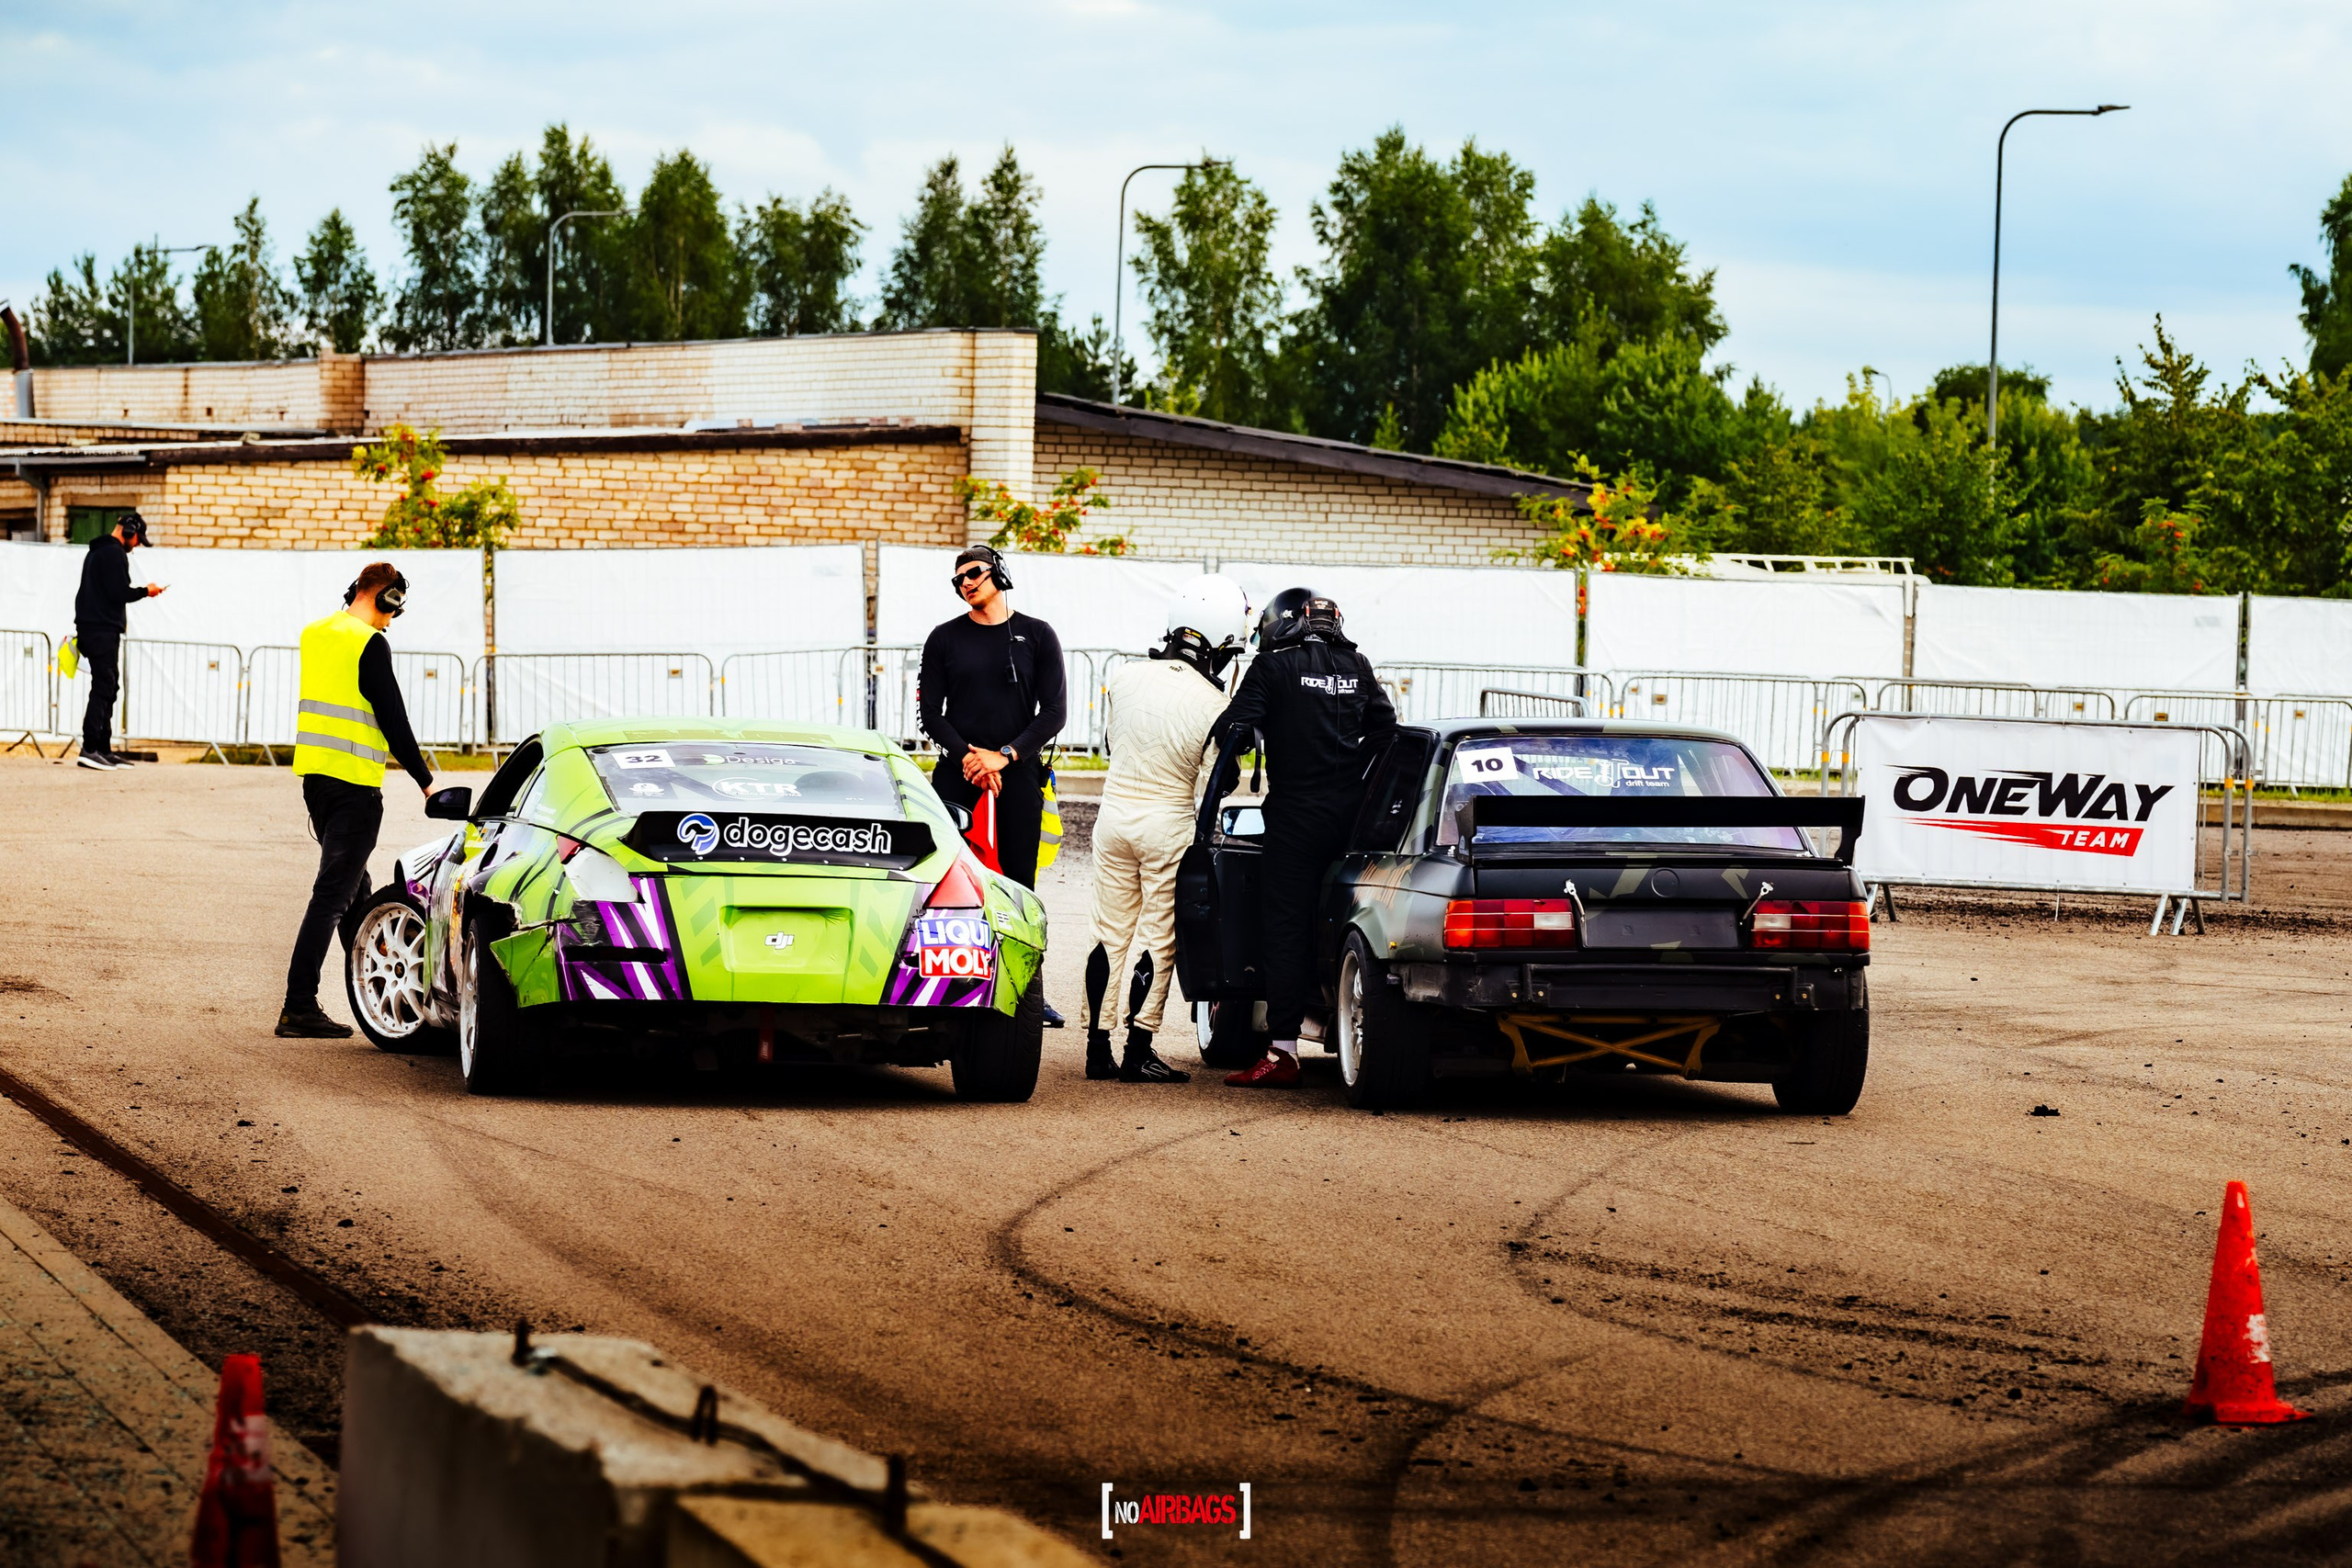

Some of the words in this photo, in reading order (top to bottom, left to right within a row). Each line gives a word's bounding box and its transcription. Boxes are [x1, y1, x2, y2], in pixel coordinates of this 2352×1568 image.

[1301, 676, 1326, 688] RIDE
[1337, 679, 1359, 689] OUT
[625, 755, 662, 763] 32
[1471, 758, 1504, 773] 10
[1532, 767, 1593, 780] RIDE
[1622, 767, 1675, 780] OUT
[720, 781, 802, 796] KTR
[1625, 779, 1645, 787] drift
[723, 817, 891, 857] dogecash
[2056, 829, 2131, 849] TEAM
[764, 931, 795, 950] dji
[921, 919, 989, 950] LIQUI
[924, 948, 991, 976] MOLY
